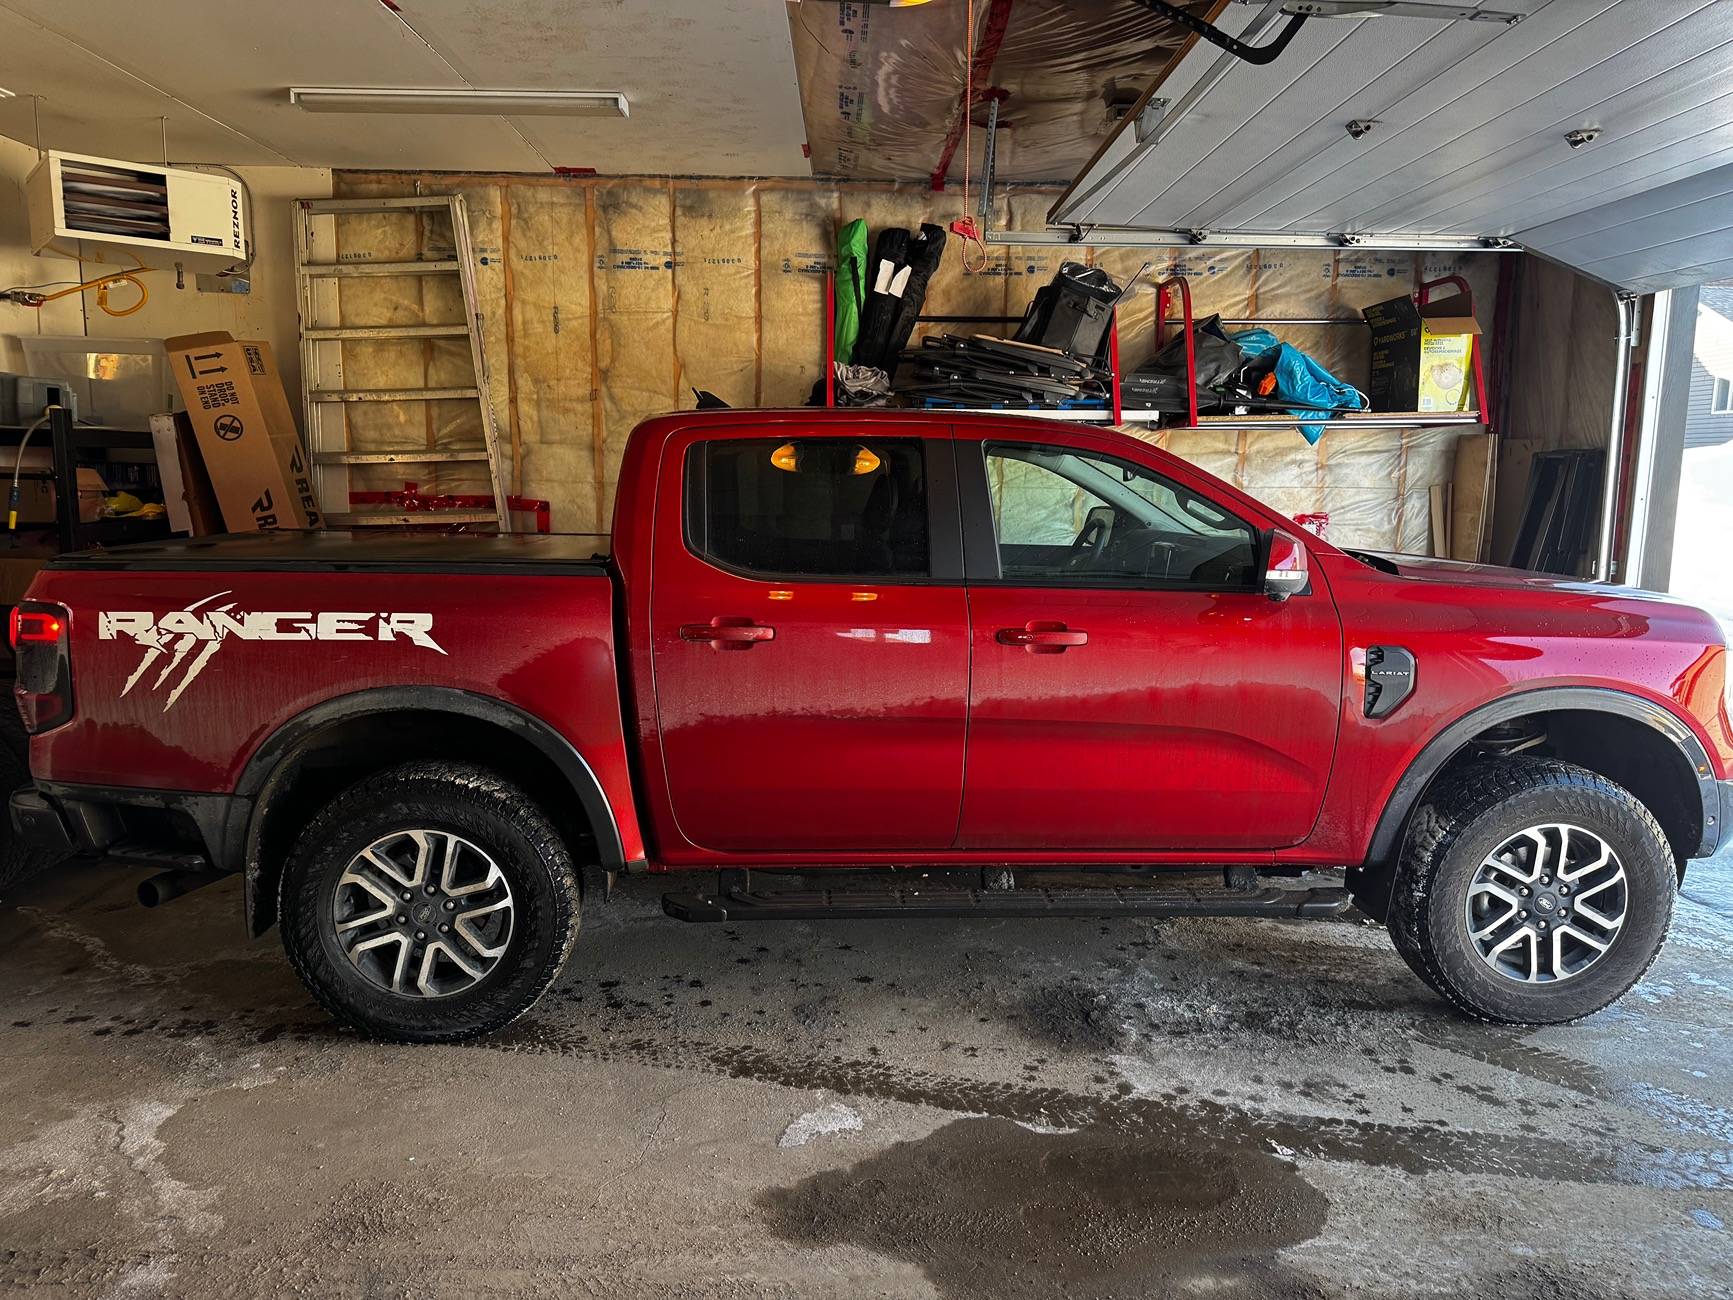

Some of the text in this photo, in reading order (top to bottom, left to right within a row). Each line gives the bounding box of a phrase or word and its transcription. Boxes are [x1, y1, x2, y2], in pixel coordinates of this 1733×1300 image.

[230, 189, 240, 249] REZNOR
[197, 385, 211, 410] ON END
[205, 384, 221, 408] STAND
[225, 381, 240, 405] DO NOT
[98, 610, 449, 656] RANGER
